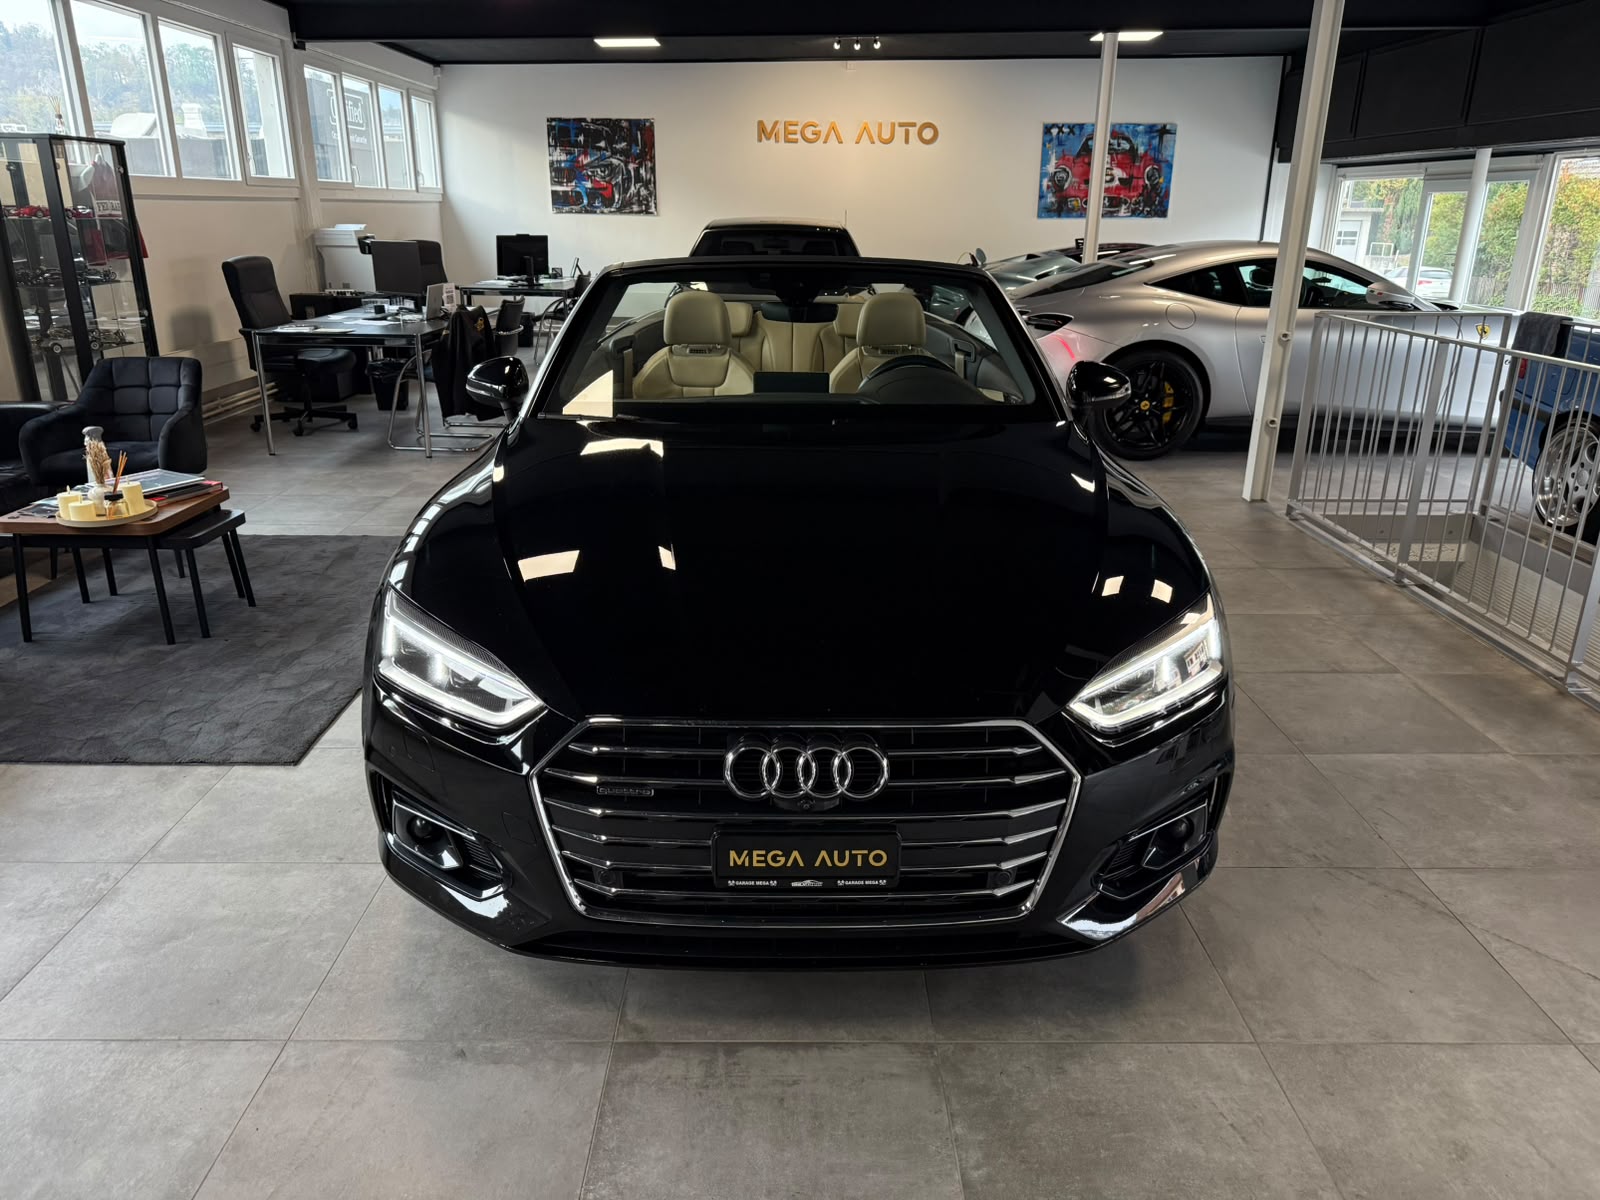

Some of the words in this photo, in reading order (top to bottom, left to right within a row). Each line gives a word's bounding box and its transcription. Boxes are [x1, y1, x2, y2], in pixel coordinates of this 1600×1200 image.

[757, 120, 843, 144] MEGA
[855, 121, 939, 145] AUTO
[729, 850, 805, 867] MEGA
[814, 850, 888, 867] AUTO
